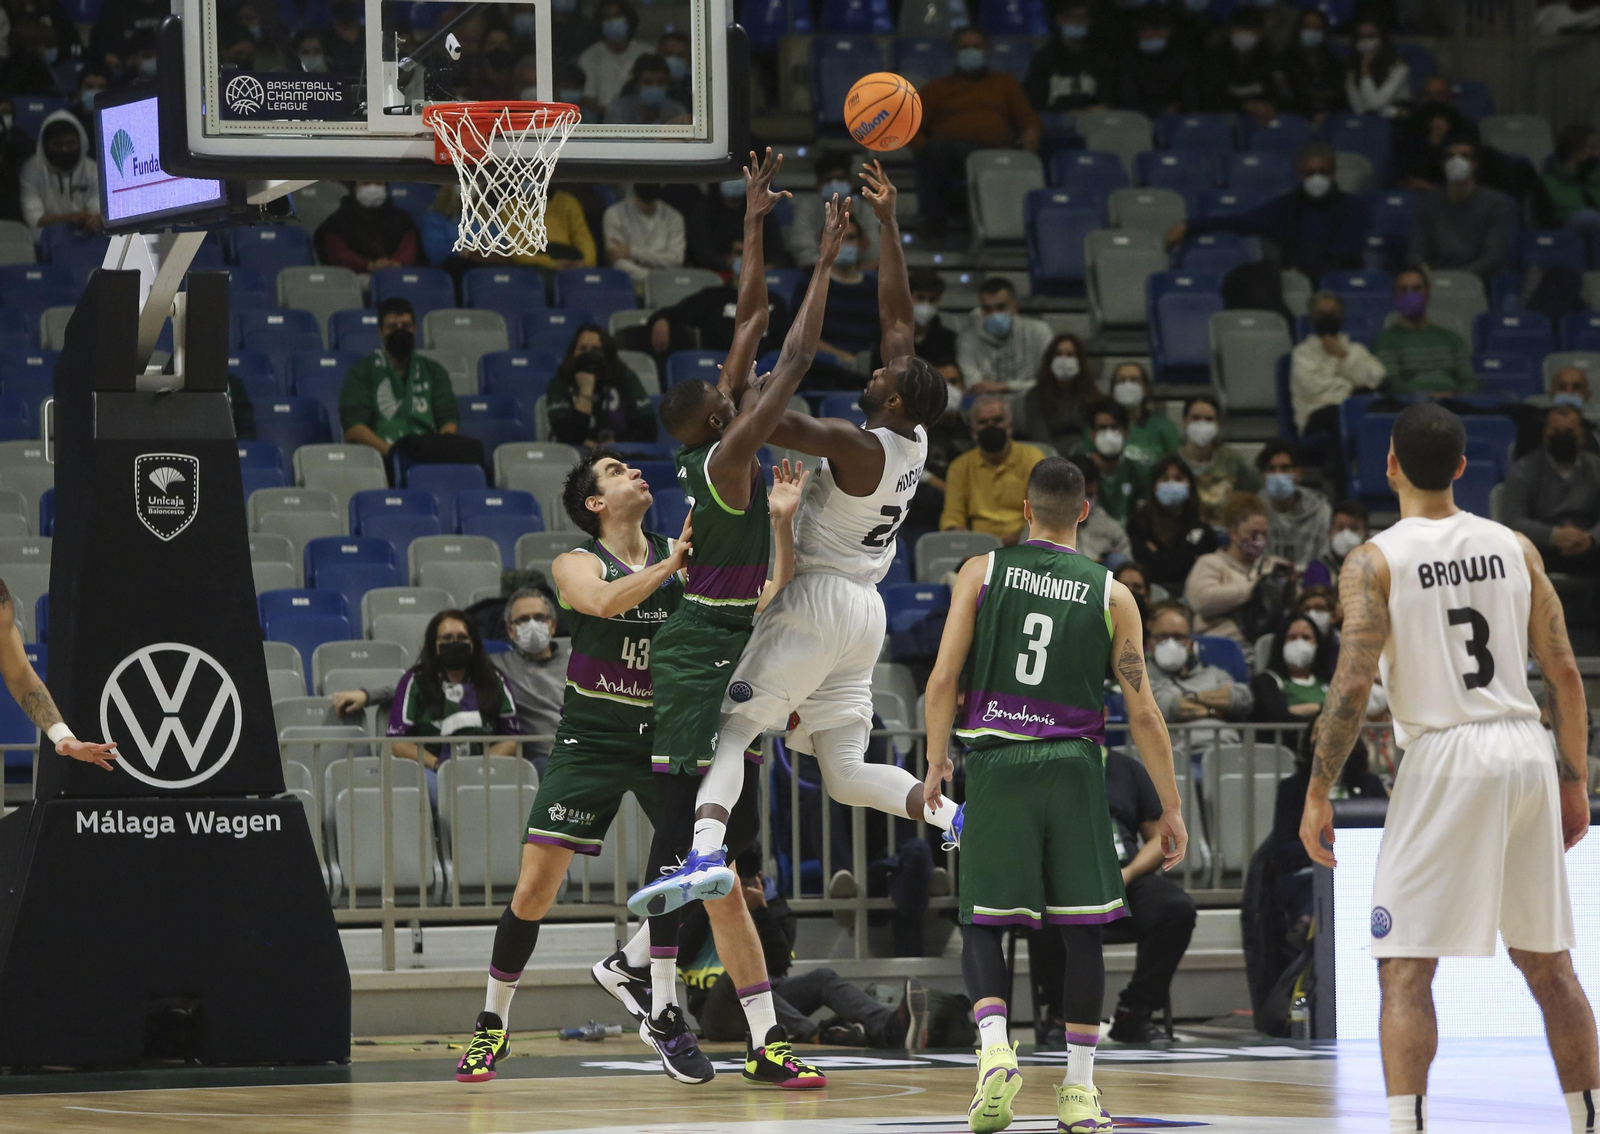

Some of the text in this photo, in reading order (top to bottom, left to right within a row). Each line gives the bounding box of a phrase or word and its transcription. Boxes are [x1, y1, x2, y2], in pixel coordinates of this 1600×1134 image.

[267, 82, 334, 90] BASKETBALL
[267, 91, 343, 101] CHAMPIONS
[267, 102, 308, 110] LEAGUE
[852, 109, 891, 141] Wilson
[148, 495, 185, 508] Unicaja
[861, 499, 912, 547] 2
[1004, 566, 1090, 604] FERNÁNDEZ
[1418, 554, 1506, 589] BROWN
[621, 636, 651, 670] 43
[1015, 612, 1053, 686] 3
[1447, 606, 1495, 691] 3
[76, 810, 281, 839] Málaga Wagen
